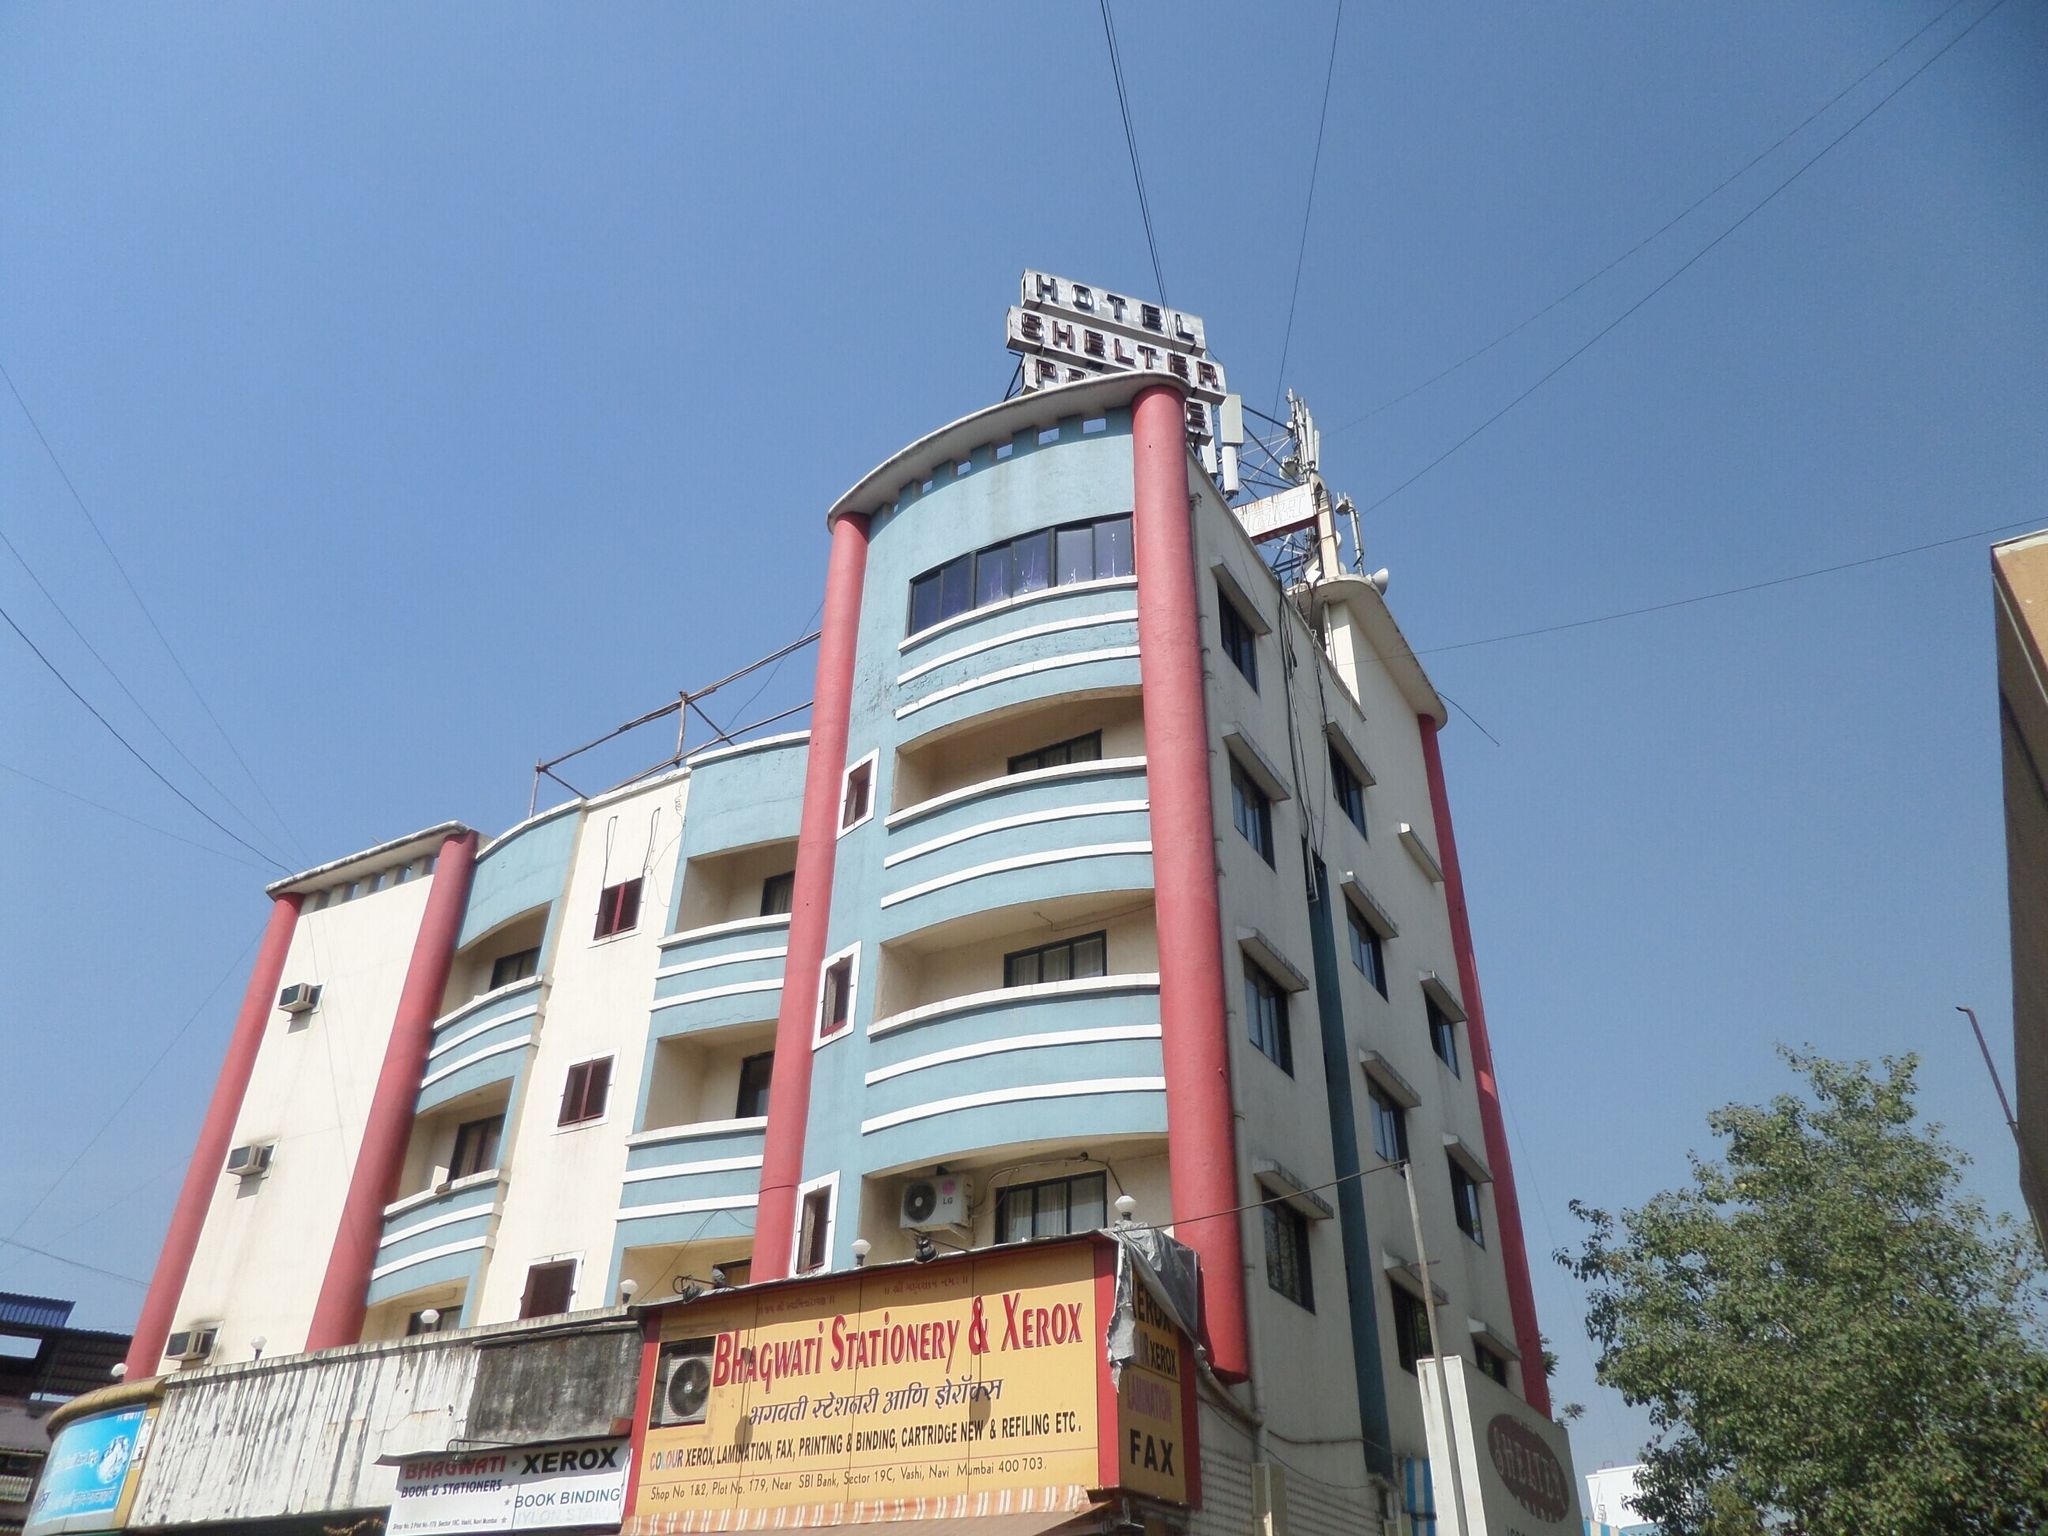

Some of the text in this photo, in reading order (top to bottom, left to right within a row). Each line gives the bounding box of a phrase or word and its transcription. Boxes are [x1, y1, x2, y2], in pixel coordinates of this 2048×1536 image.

[1036, 273, 1195, 341] HOTEL
[1021, 312, 1218, 388] SHELTER
[943, 1197, 953, 1205] LG
[968, 1296, 990, 1355] &
[1001, 1292, 1083, 1351] XEROX
[1150, 1341, 1177, 1377] XEROX
[750, 1395, 808, 1425] भगवती
[812, 1387, 880, 1419] स्टेशनरी
[882, 1381, 930, 1414] आणि
[404, 1446, 619, 1480] BHAGWATI XEROX
[649, 1449, 683, 1472] COLOUR
[685, 1446, 716, 1470] XEROX,
[775, 1438, 797, 1462] FAX,
[798, 1434, 843, 1457] PRINTING
[846, 1433, 853, 1452] &
[855, 1428, 899, 1453] BINDING,
[901, 1422, 957, 1447] CARTRIDGE
[960, 1419, 984, 1442] NEW
[989, 1418, 996, 1440] &
[1001, 1413, 1050, 1439] REFILING
[1130, 1428, 1174, 1476] FAX
[401, 1485, 430, 1499] BOOK
[442, 1479, 503, 1495] STATIONERS
[514, 1488, 620, 1509] BOOK BINDING
[651, 1486, 670, 1502] Shop
[672, 1485, 685, 1499] No
[712, 1481, 728, 1495] Plot
[771, 1476, 792, 1491] Near
[798, 1474, 814, 1489] SBI
[816, 1472, 839, 1488] Bank,
[843, 1471, 870, 1486] Sector
[928, 1465, 950, 1479] Navi
[956, 1461, 995, 1476] Mumbai
[998, 1459, 1020, 1472] 400
